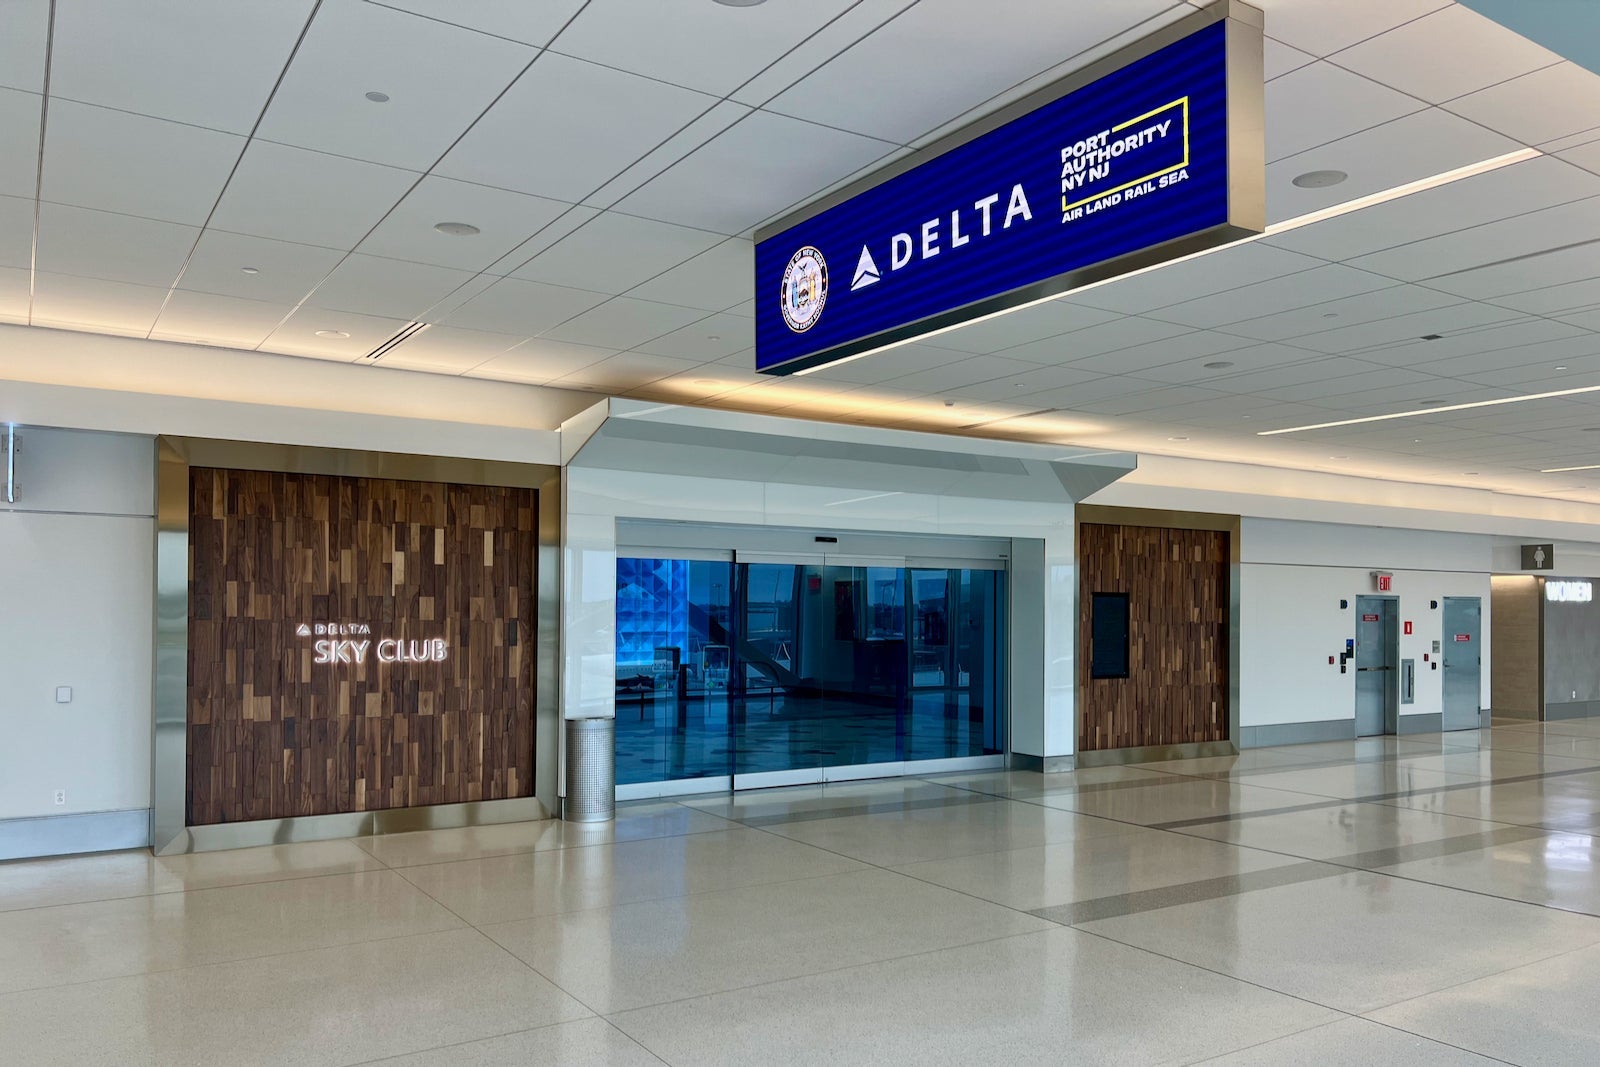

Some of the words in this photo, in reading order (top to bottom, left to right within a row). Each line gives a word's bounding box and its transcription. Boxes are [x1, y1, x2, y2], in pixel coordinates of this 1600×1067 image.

[1061, 129, 1110, 163] PORT
[1061, 119, 1171, 178] AUTHORITY
[1061, 170, 1086, 193] NY
[1088, 161, 1109, 182] NJ
[1061, 207, 1083, 223] AIR
[1086, 193, 1122, 215] LAND
[1124, 181, 1156, 201] RAIL
[1158, 169, 1189, 188] SEA
[891, 183, 1033, 271] DELTA
[1379, 576, 1392, 591] EXIT
[1545, 581, 1592, 602] WOMEN
[314, 622, 371, 635] DELTA
[314, 639, 371, 664] SKY
[377, 638, 448, 662] CLUB
